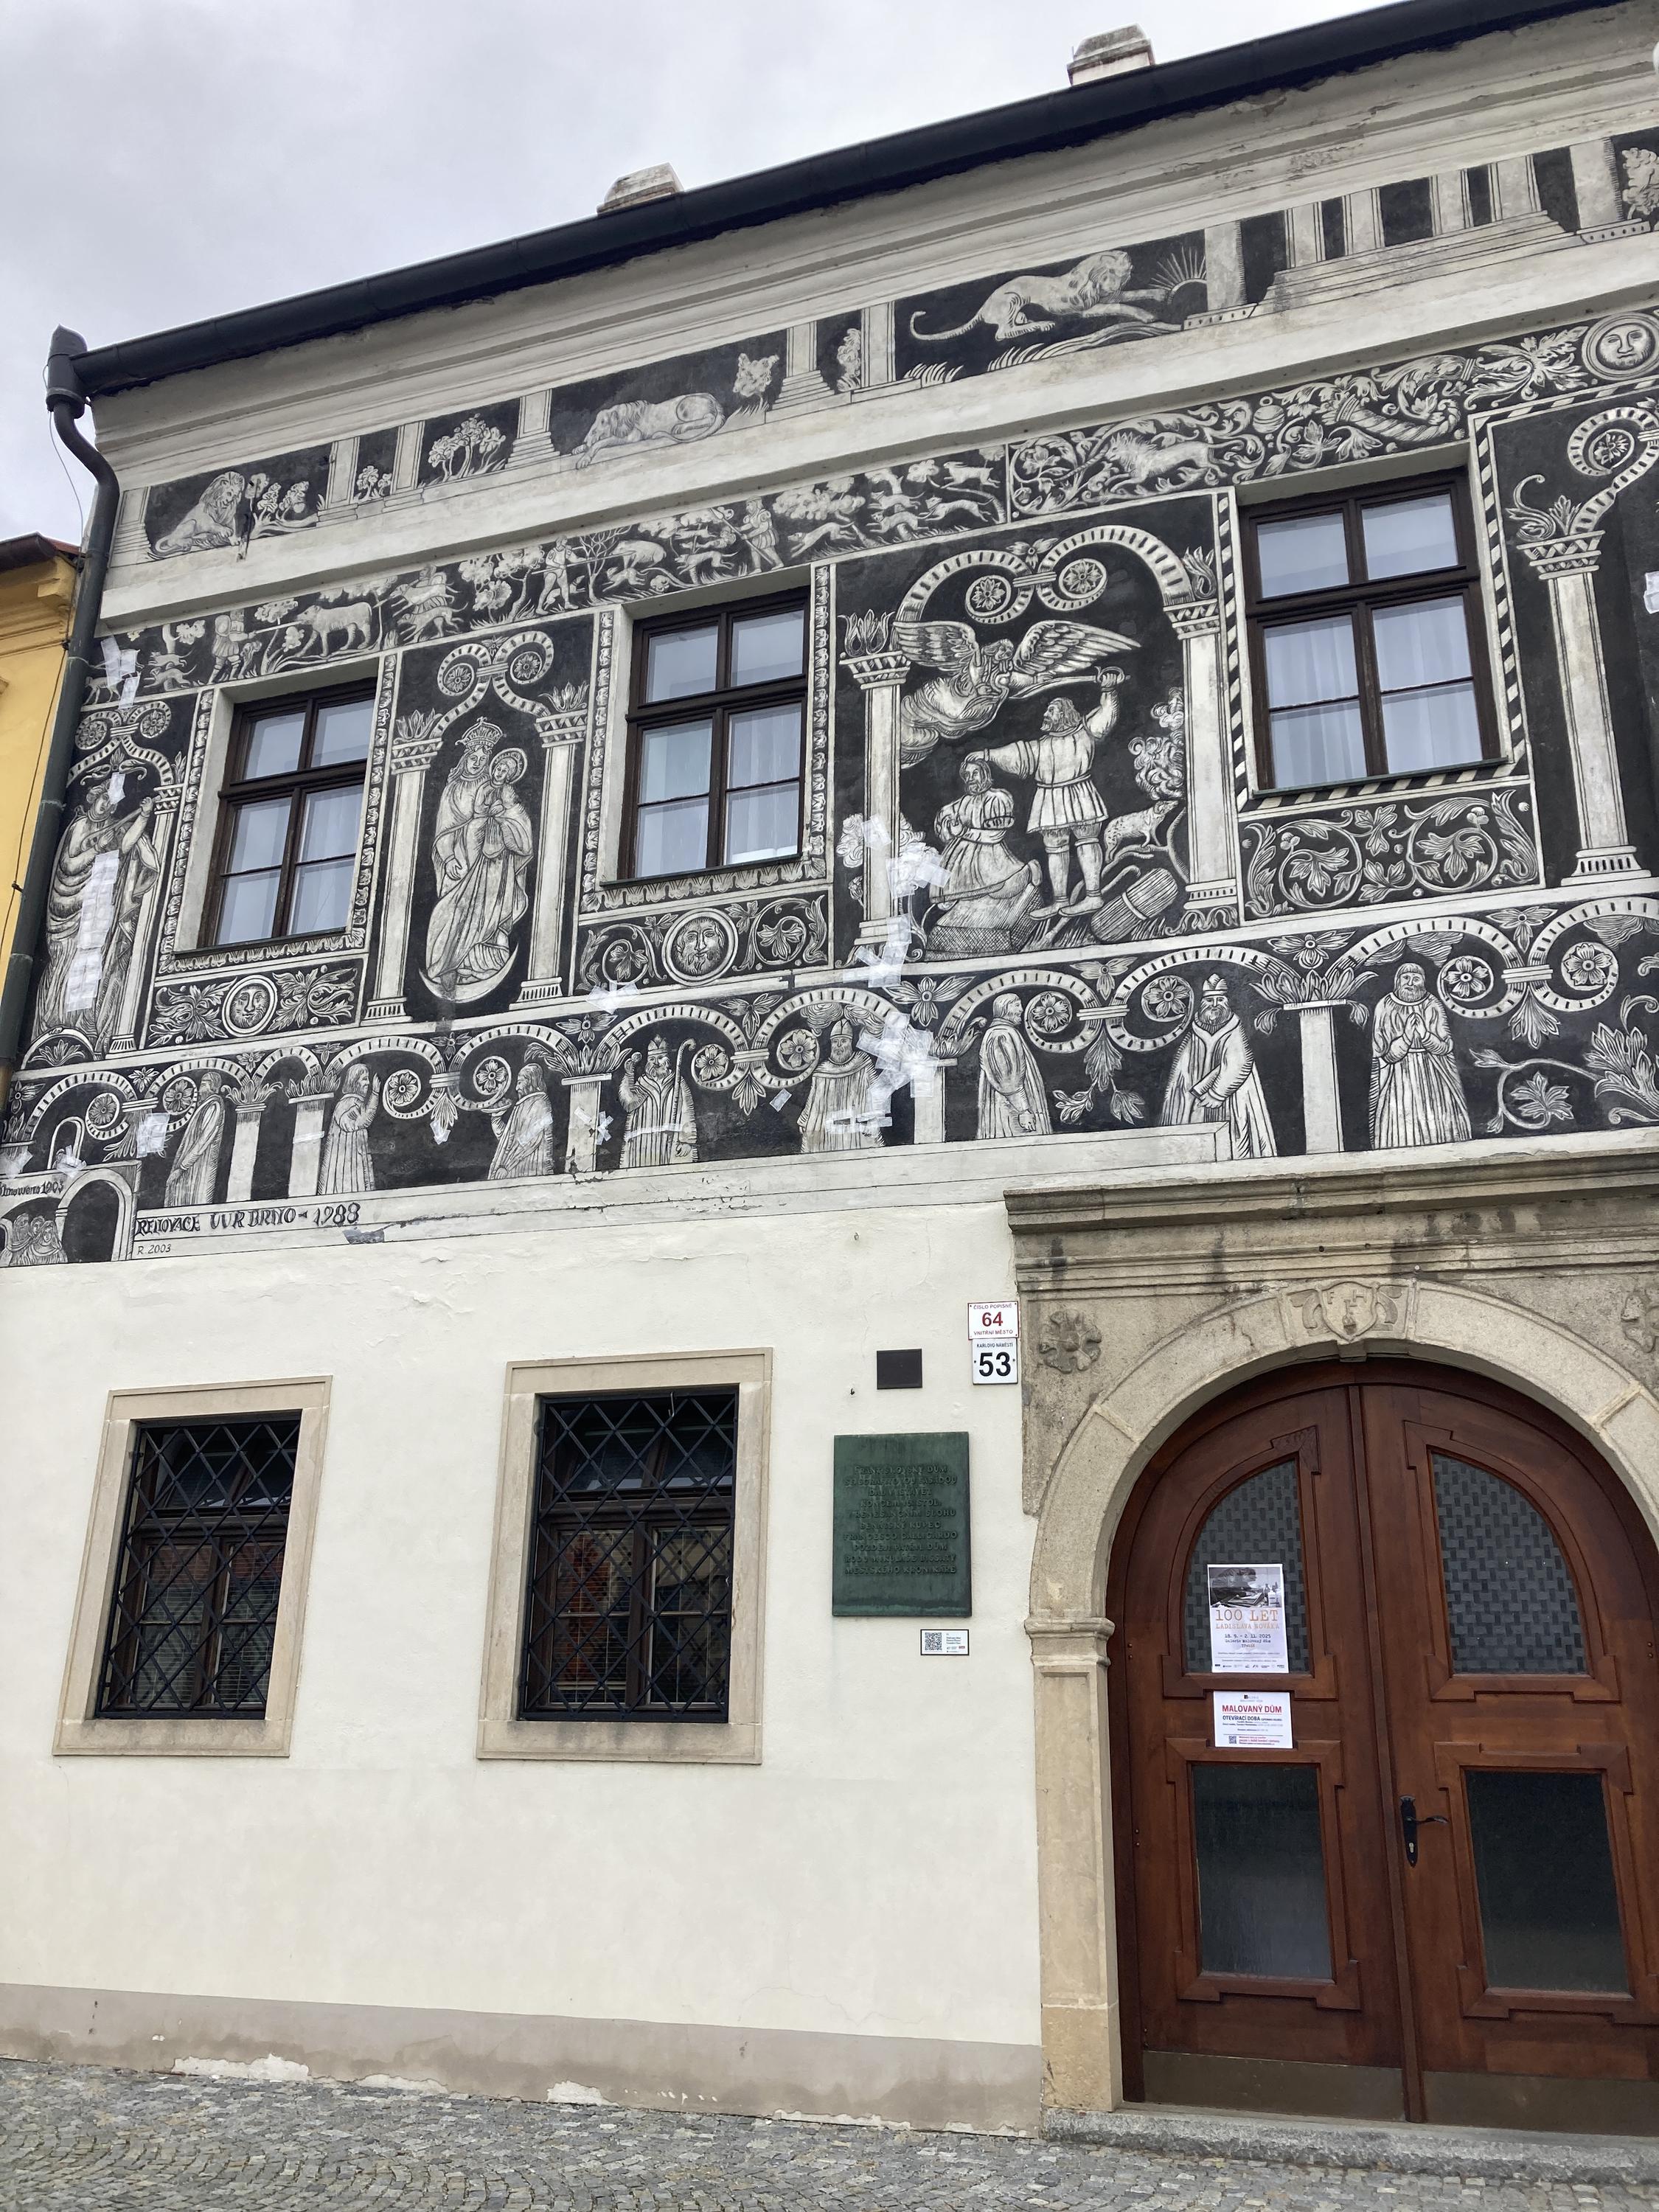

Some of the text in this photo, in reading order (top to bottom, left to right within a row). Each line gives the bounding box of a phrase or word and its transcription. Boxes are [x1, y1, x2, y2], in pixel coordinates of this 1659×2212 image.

[248, 1208, 296, 1227] BRNO
[313, 1202, 361, 1227] 1988
[147, 1243, 171, 1254] 2003
[981, 1312, 1004, 1327] 64
[978, 1352, 1011, 1377] 53
[925, 1509, 956, 1517] SLOHU
[909, 1520, 942, 1528] KUPEC
[1215, 1609, 1278, 1621] 100 LET
[1222, 1704, 1282, 1713] MALOVANÝ DŮM
